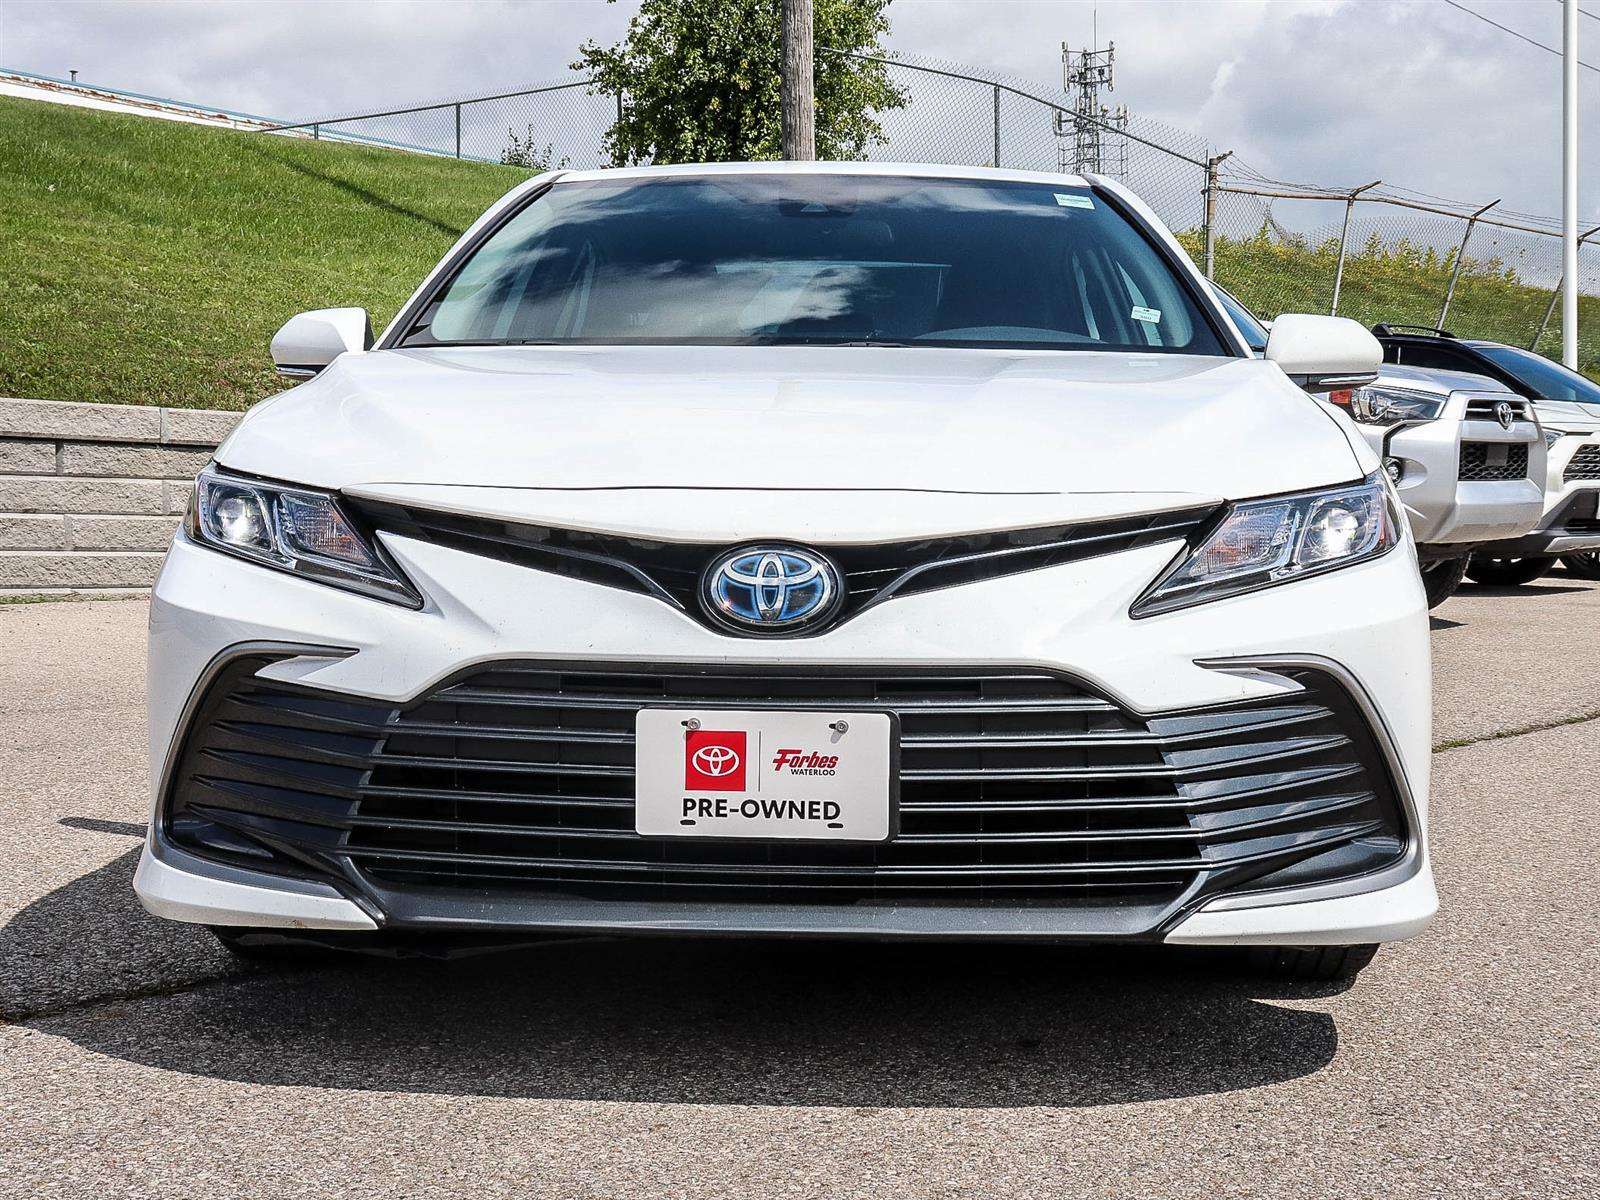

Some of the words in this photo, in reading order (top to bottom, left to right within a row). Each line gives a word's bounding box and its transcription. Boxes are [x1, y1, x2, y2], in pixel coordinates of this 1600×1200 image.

[772, 748, 839, 771] Forbes
[790, 768, 836, 776] WATERLOO
[682, 798, 841, 820] PRE-OWNED
